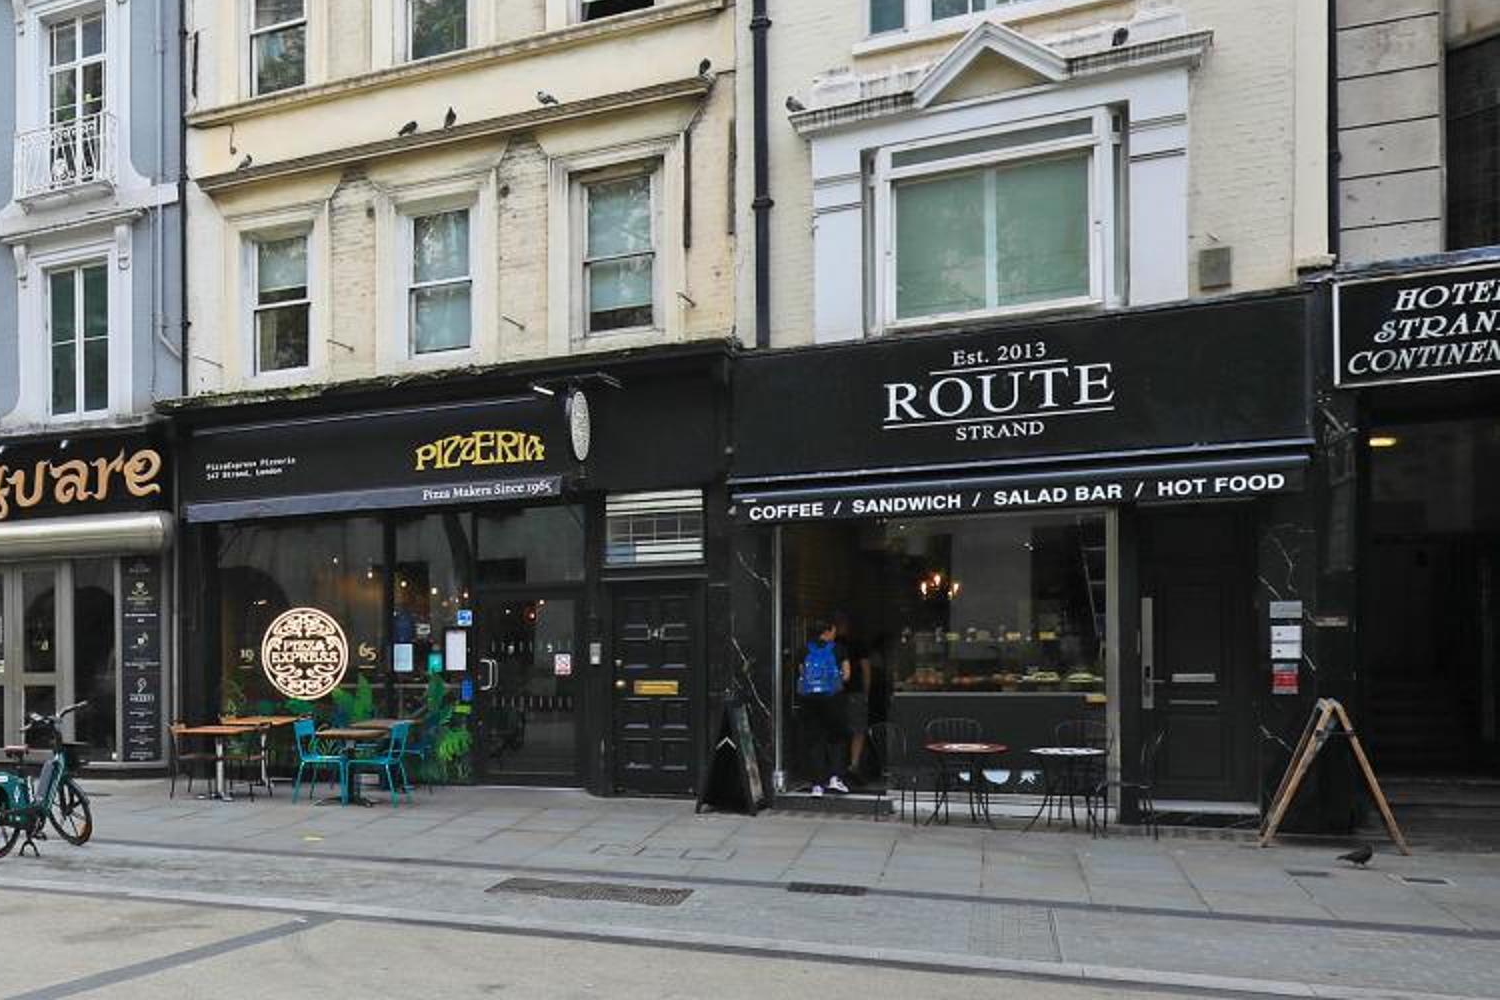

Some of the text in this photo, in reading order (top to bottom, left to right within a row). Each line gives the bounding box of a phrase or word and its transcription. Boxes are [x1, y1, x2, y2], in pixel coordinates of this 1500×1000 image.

[1374, 310, 1500, 343] STRAN
[952, 342, 1046, 366] Est. 2013
[883, 363, 1115, 422] ROUTE
[955, 421, 1045, 441] STRAND
[423, 489, 450, 501] Pizza
[452, 485, 491, 499] Makers
[494, 482, 525, 495] Since
[749, 502, 825, 520] COFFEE
[852, 494, 961, 513] SANDWICH
[993, 487, 1067, 506] SALAD
[1075, 484, 1123, 501] BAR
[1157, 479, 1206, 496] HOT
[1214, 473, 1285, 493] FOOD
[240, 648, 254, 661] 19
[358, 642, 376, 661] 65
[271, 651, 339, 662] EXPRESS
